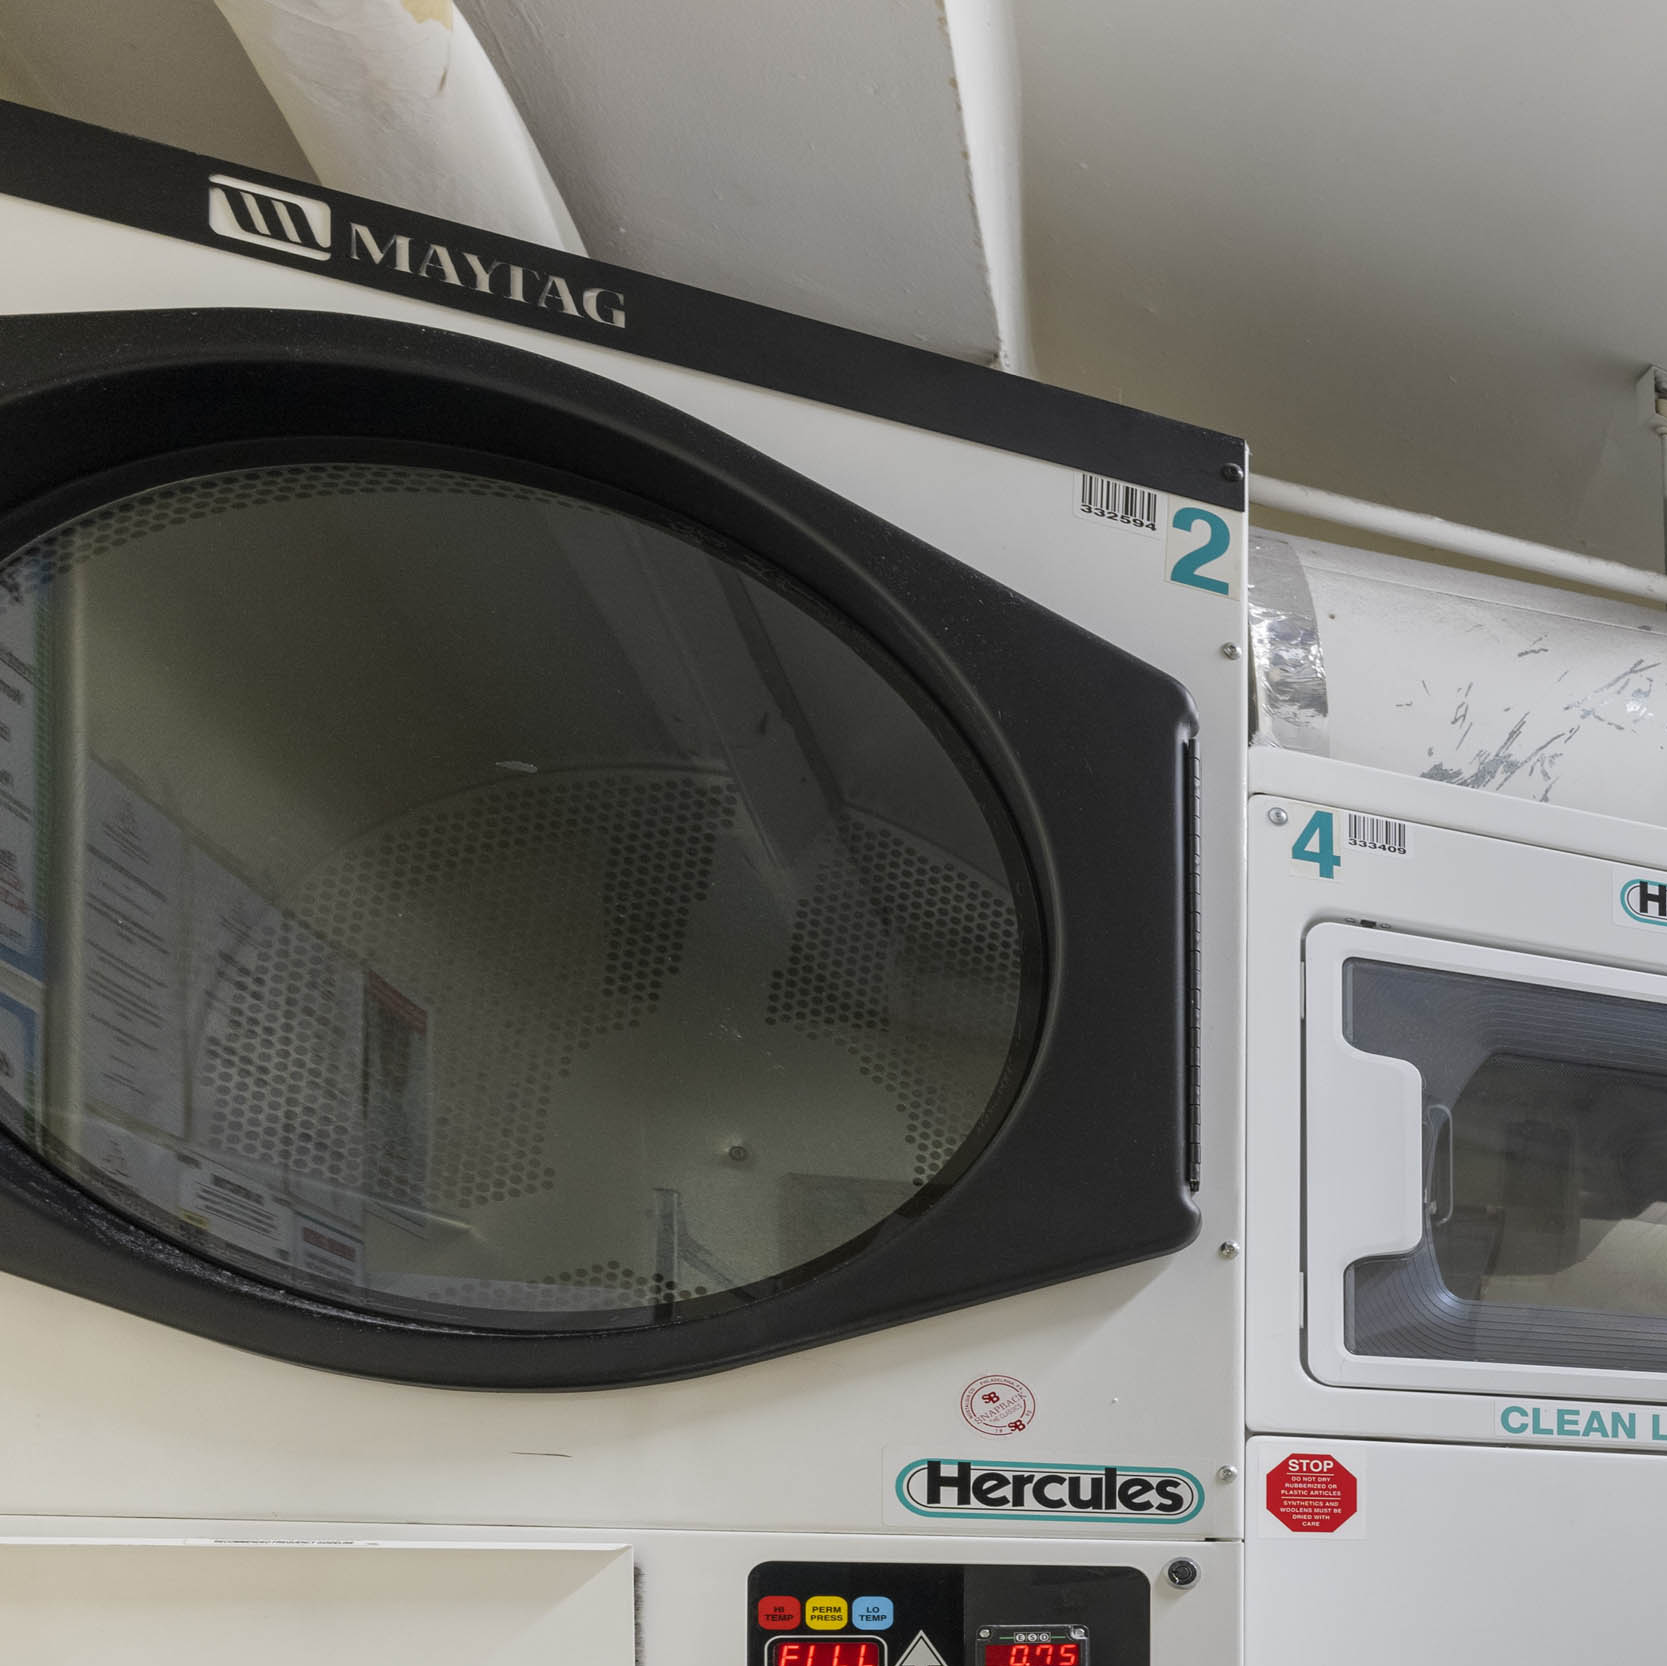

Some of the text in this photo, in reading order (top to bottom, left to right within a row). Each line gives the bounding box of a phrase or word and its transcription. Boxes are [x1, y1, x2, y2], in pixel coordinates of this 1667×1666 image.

[350, 222, 626, 328] MAYTAG
[1080, 505, 1157, 531] 332594
[1171, 507, 1230, 595] 2
[1292, 810, 1341, 879] 4
[1348, 839, 1406, 854] 333409
[1500, 1405, 1636, 1439] CLEAN
[1288, 1459, 1334, 1472] STOP
[927, 1461, 1184, 1513] Hercules
[1010, 1645, 1077, 1666] 0.75
